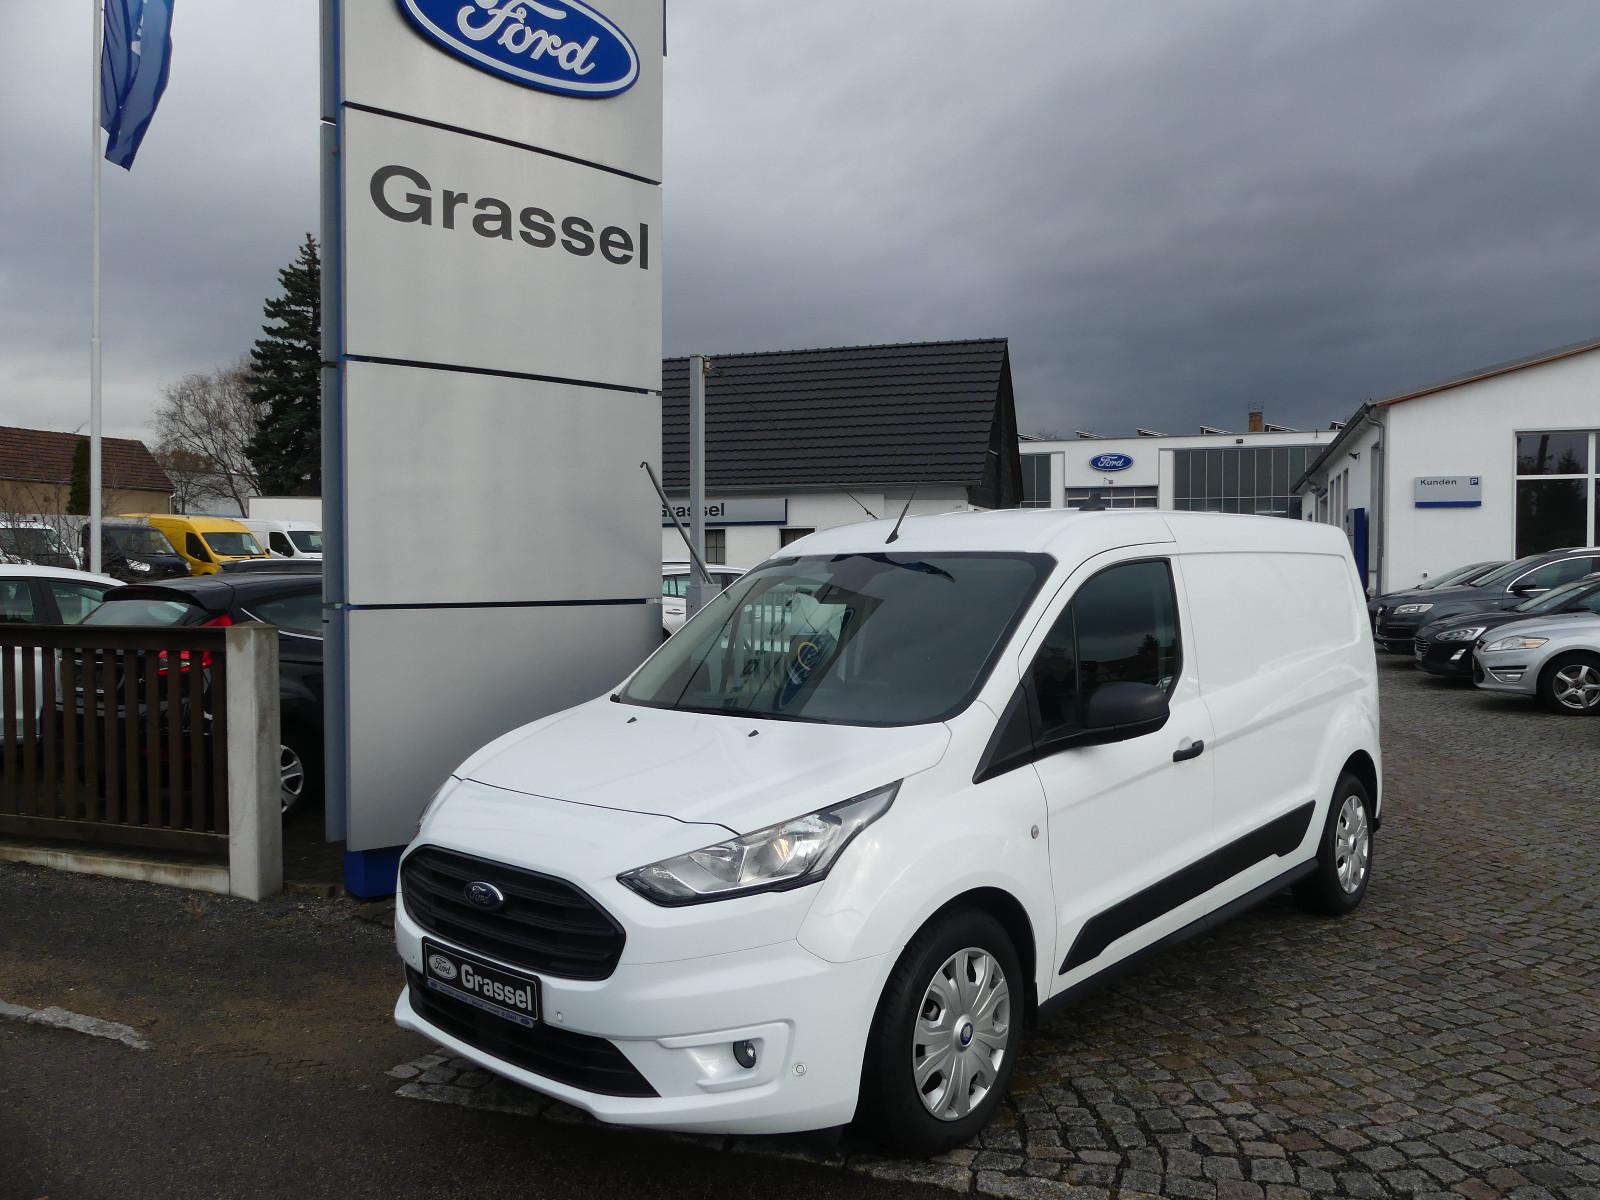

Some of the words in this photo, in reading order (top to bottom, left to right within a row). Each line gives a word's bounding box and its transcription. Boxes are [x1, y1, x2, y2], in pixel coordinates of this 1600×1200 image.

[457, 0, 600, 76] Ford
[369, 164, 649, 270] Grassel
[1098, 456, 1125, 467] Ford
[460, 963, 533, 1012] Grassel
